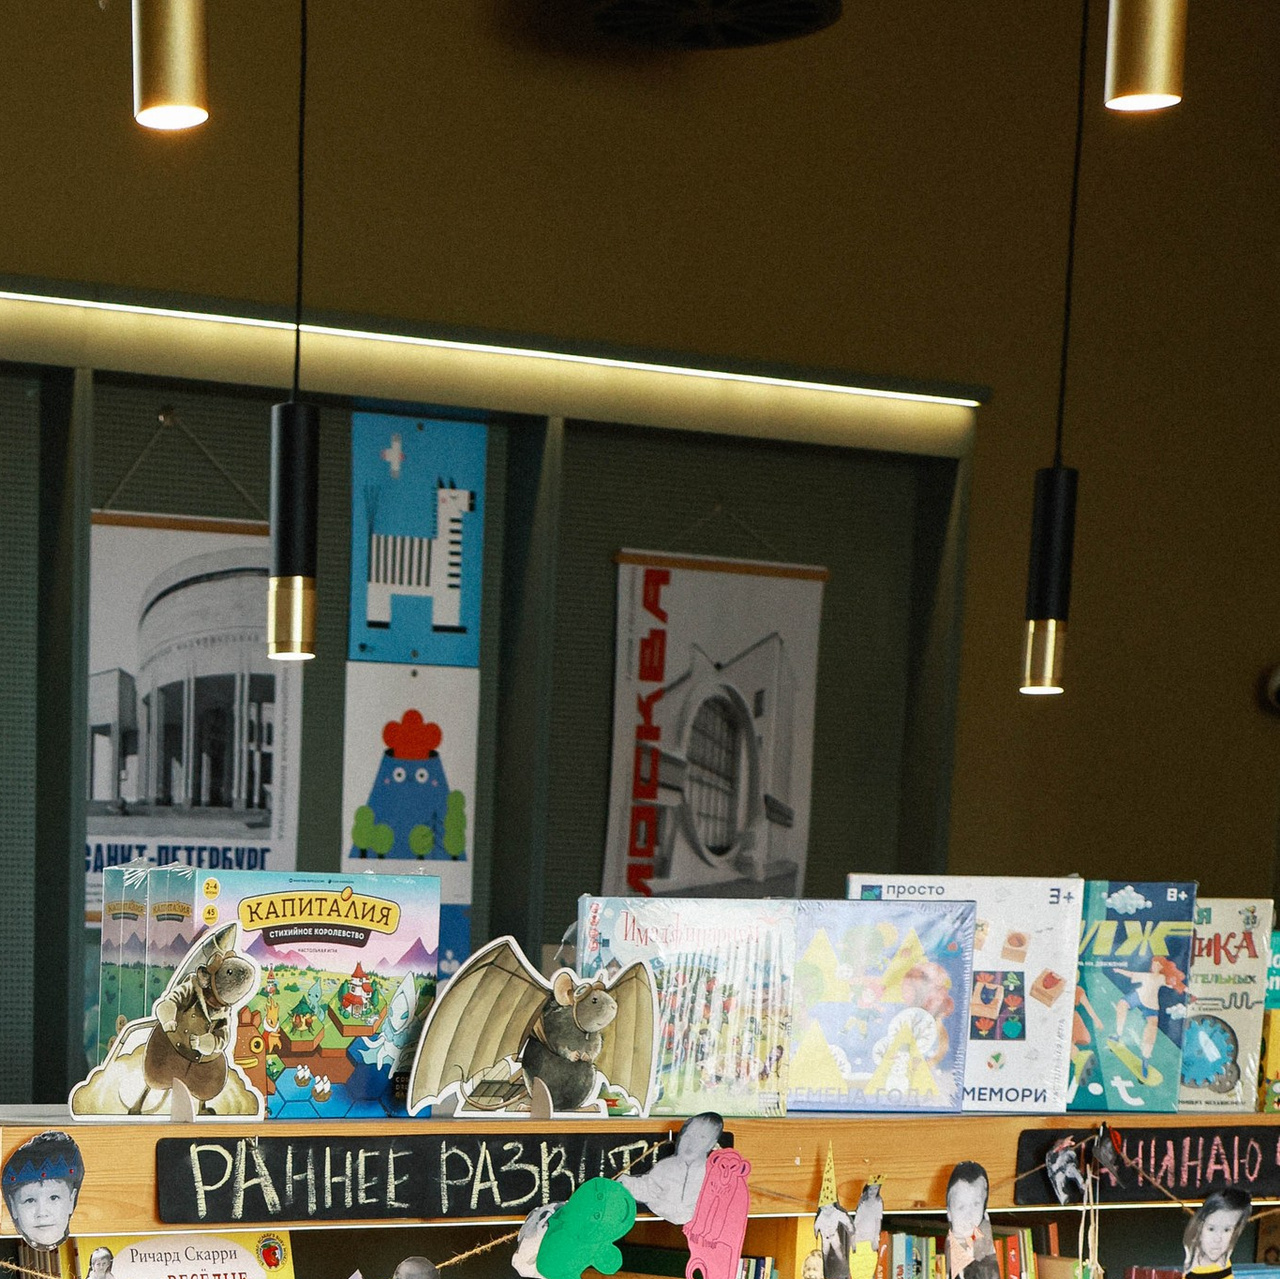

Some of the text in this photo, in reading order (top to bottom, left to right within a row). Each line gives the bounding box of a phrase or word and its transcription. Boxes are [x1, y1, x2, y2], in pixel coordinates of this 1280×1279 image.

[205, 883, 218, 891] 2-4
[886, 883, 945, 898] просто
[1049, 888, 1075, 905] 3+
[1166, 889, 1188, 903] 8+
[206, 908, 215, 917] 45
[248, 897, 392, 926] КАПИТАЛИЯ
[269, 927, 365, 941] СТИХИЙНОЕ КОРОЛЕВСТВО
[962, 1086, 1047, 1104] МЕМОРИ
[189, 1138, 414, 1223] РАННЕЕ
[130, 1246, 237, 1265] Ричард Скарри
